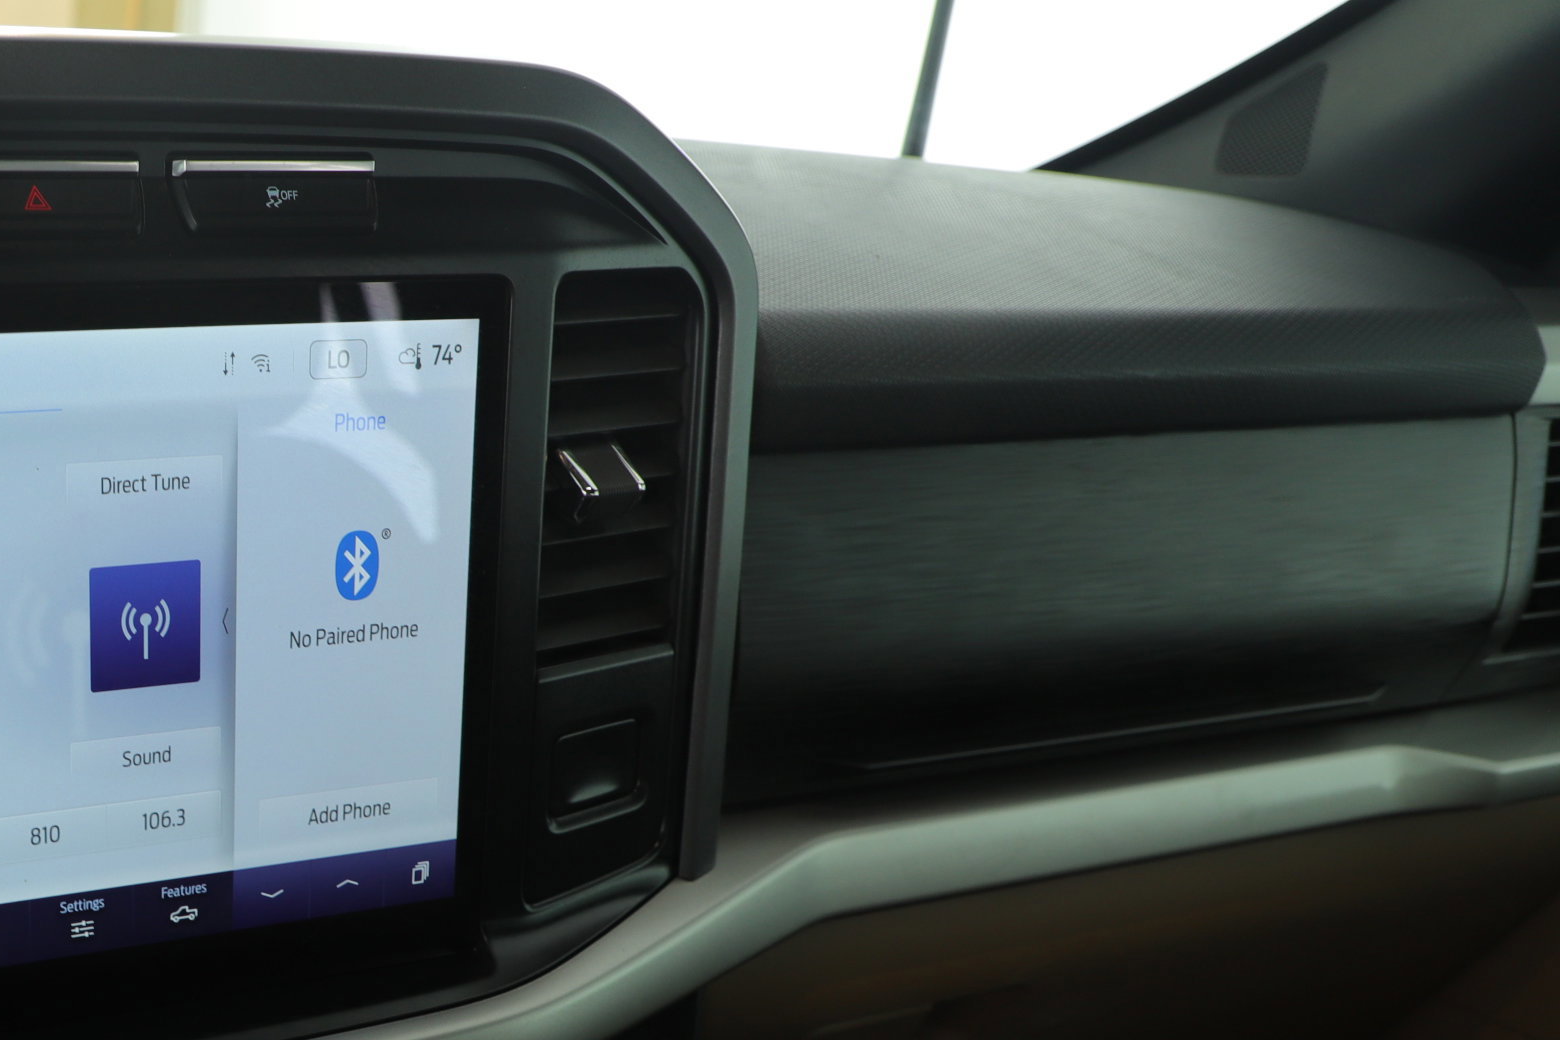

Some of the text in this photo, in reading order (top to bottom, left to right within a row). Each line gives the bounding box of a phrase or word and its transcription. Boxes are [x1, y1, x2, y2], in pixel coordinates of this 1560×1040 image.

[280, 189, 299, 201] OFF
[327, 343, 463, 370] LO 74°
[334, 412, 387, 432] Phone
[100, 472, 191, 495] Direct Tune
[289, 621, 419, 649] No Paired Phone
[121, 745, 172, 768] Sound
[308, 800, 391, 826] Add Phone
[29, 824, 61, 847] 810
[142, 808, 186, 831] 106.3
[59, 896, 105, 915] Settings
[160, 881, 207, 899] Features
